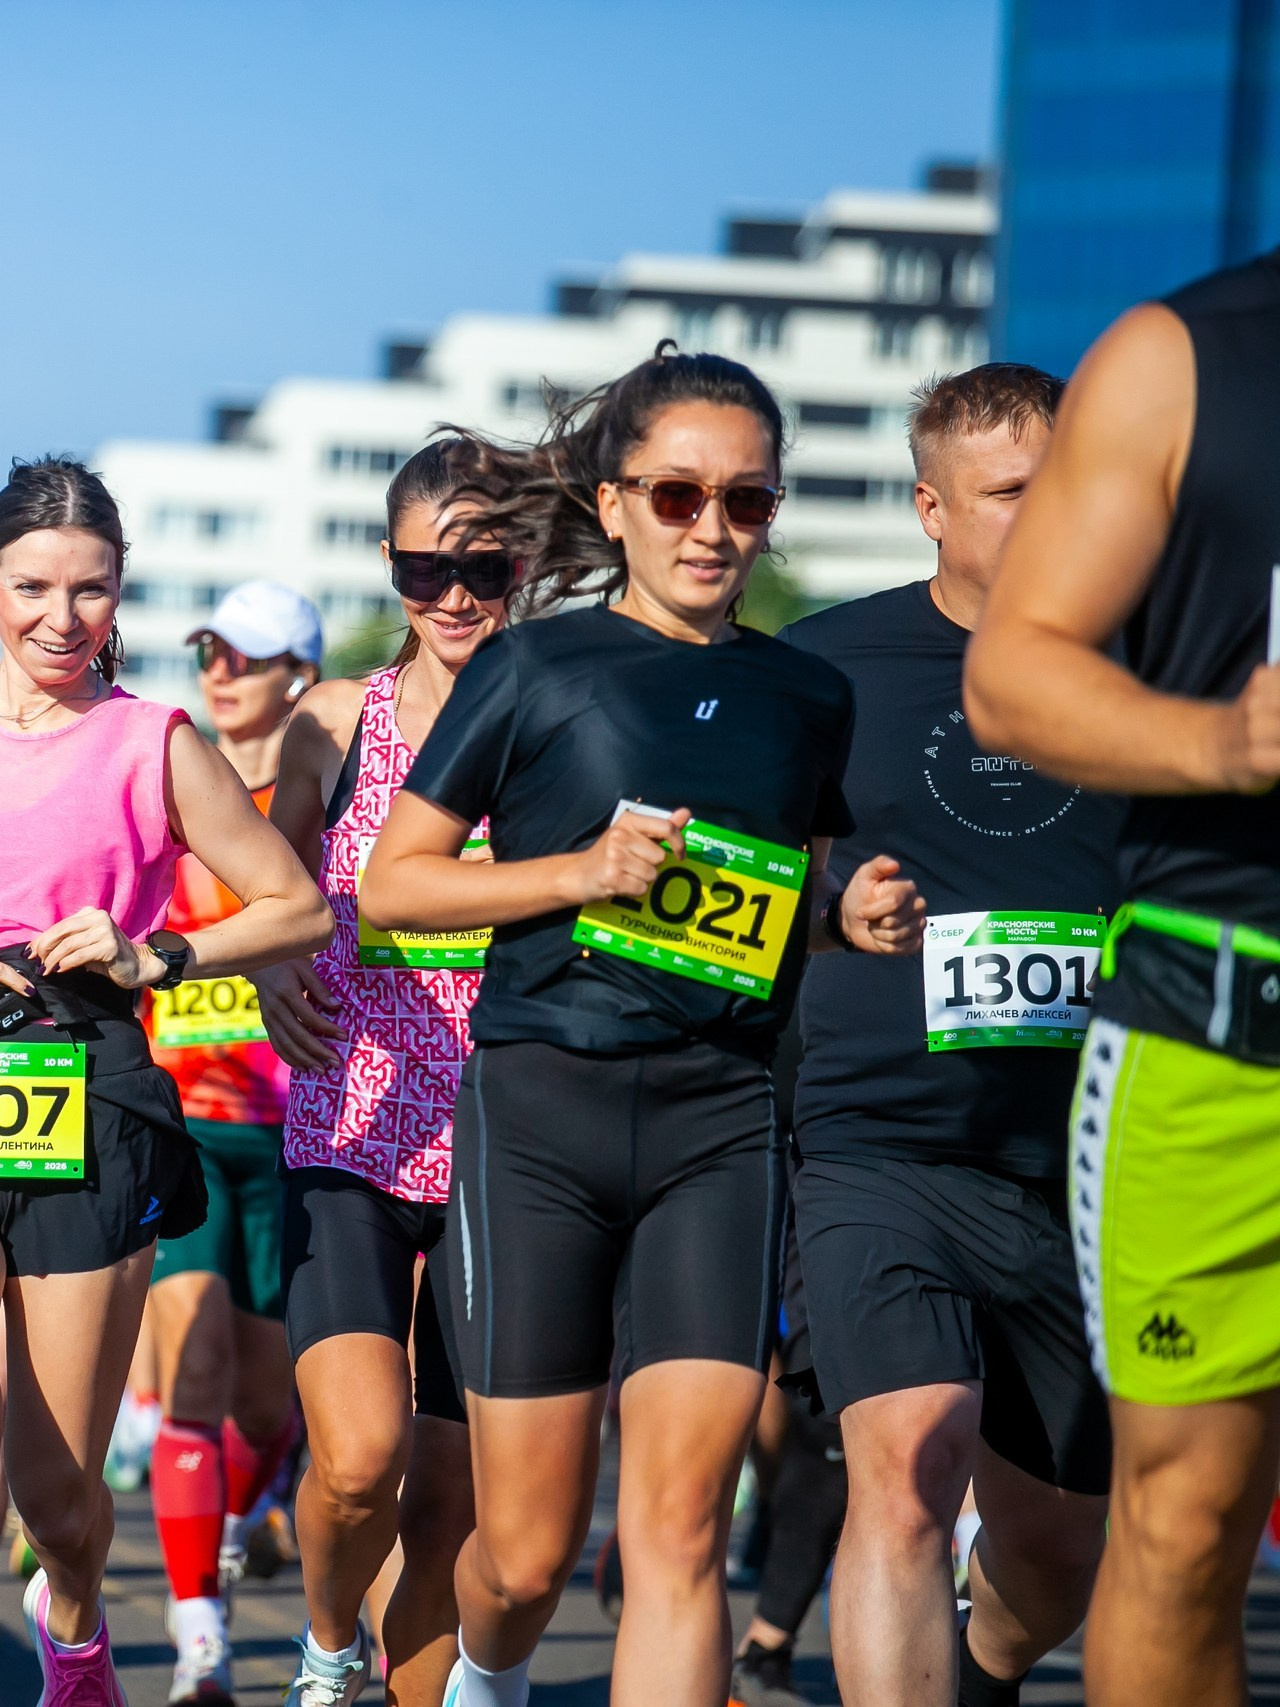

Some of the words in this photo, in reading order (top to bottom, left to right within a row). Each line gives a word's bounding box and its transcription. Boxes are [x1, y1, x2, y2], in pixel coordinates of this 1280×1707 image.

[924, 770, 939, 798] STRIVE
[940, 801, 955, 815] FOR
[957, 816, 1013, 837] EXCELLENCE
[1025, 826, 1036, 834] BE
[1040, 816, 1056, 828] THE
[1058, 796, 1075, 816] BEST
[767, 861, 778, 872] 10
[779, 865, 794, 876] КМ
[987, 921, 1055, 929] КРАСНОЯРСКИЕ
[446, 931, 493, 940] ЕКАТЕРИ
[941, 928, 964, 938] СБЕР
[1006, 928, 1038, 936] МОСТЫ
[1071, 928, 1082, 936] 10
[1083, 928, 1097, 937] КМ
[620, 914, 684, 942] ТУРЧЕНКО
[685, 936, 746, 962] ВИКТОРИЯ
[733, 973, 756, 988] 2026
[944, 953, 1092, 1008] 1301
[965, 1010, 1019, 1020] ЛИХАЧЕВ
[1021, 1008, 1072, 1020] АЛЕКСЕЙ
[1072, 1032, 1087, 1041] 202
[44, 1058, 54, 1066] 10
[57, 1058, 73, 1067] КМ
[44, 1162, 67, 1170] 2026
